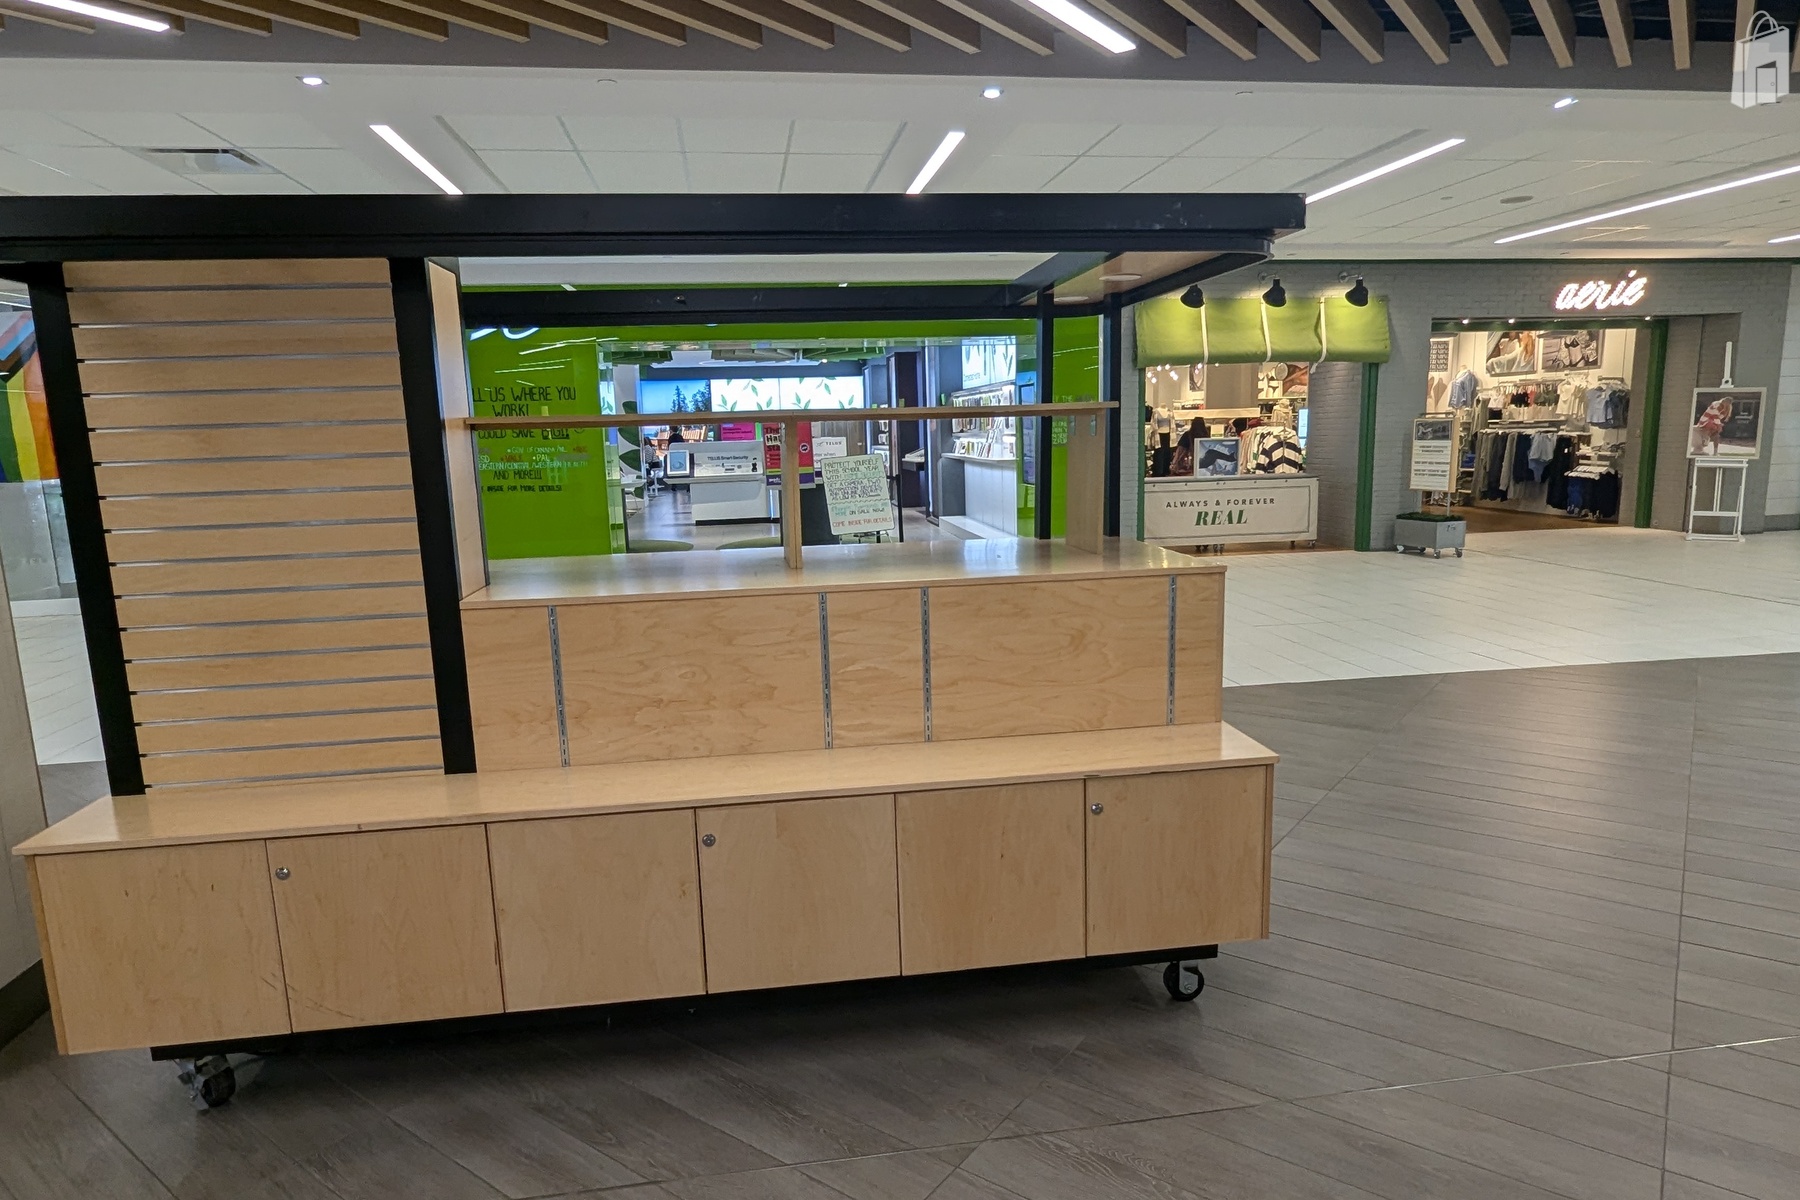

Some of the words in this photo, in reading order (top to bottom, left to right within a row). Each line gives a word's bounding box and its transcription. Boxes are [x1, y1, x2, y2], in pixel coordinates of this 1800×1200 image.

[1554, 269, 1648, 310] aerie
[489, 387, 506, 403] US
[510, 386, 553, 402] WHERE
[556, 386, 576, 401] YOU
[1165, 500, 1209, 509] ALWAYS
[1215, 499, 1221, 507] &
[1226, 498, 1276, 506] FOREVER
[1194, 509, 1248, 527] REAL
